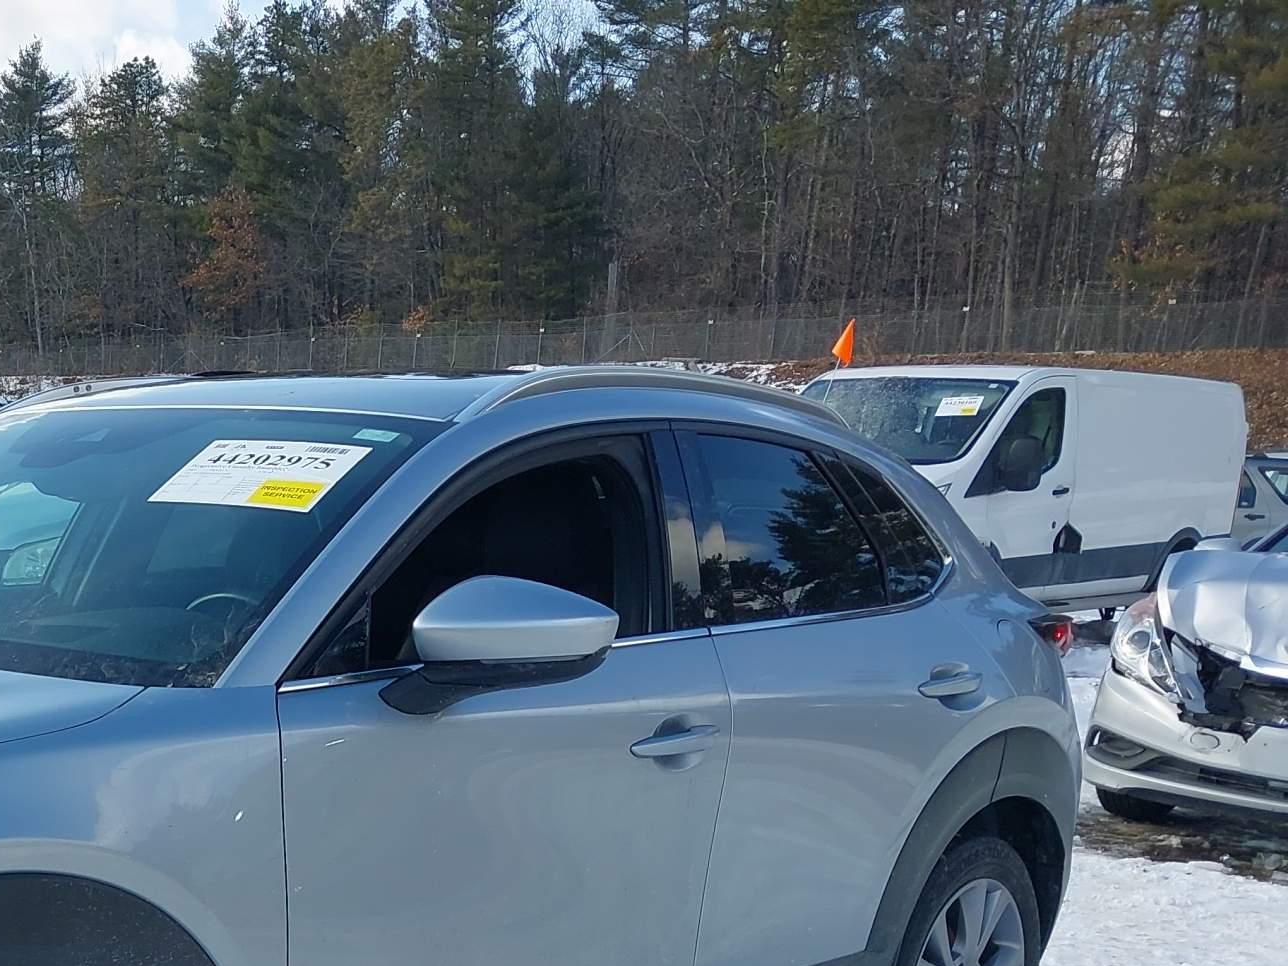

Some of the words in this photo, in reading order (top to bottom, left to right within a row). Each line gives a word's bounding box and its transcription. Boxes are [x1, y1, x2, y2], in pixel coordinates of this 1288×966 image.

[207, 453, 337, 470] 44202975
[261, 484, 318, 495] INSPECTION
[262, 491, 306, 500] SERVICE
